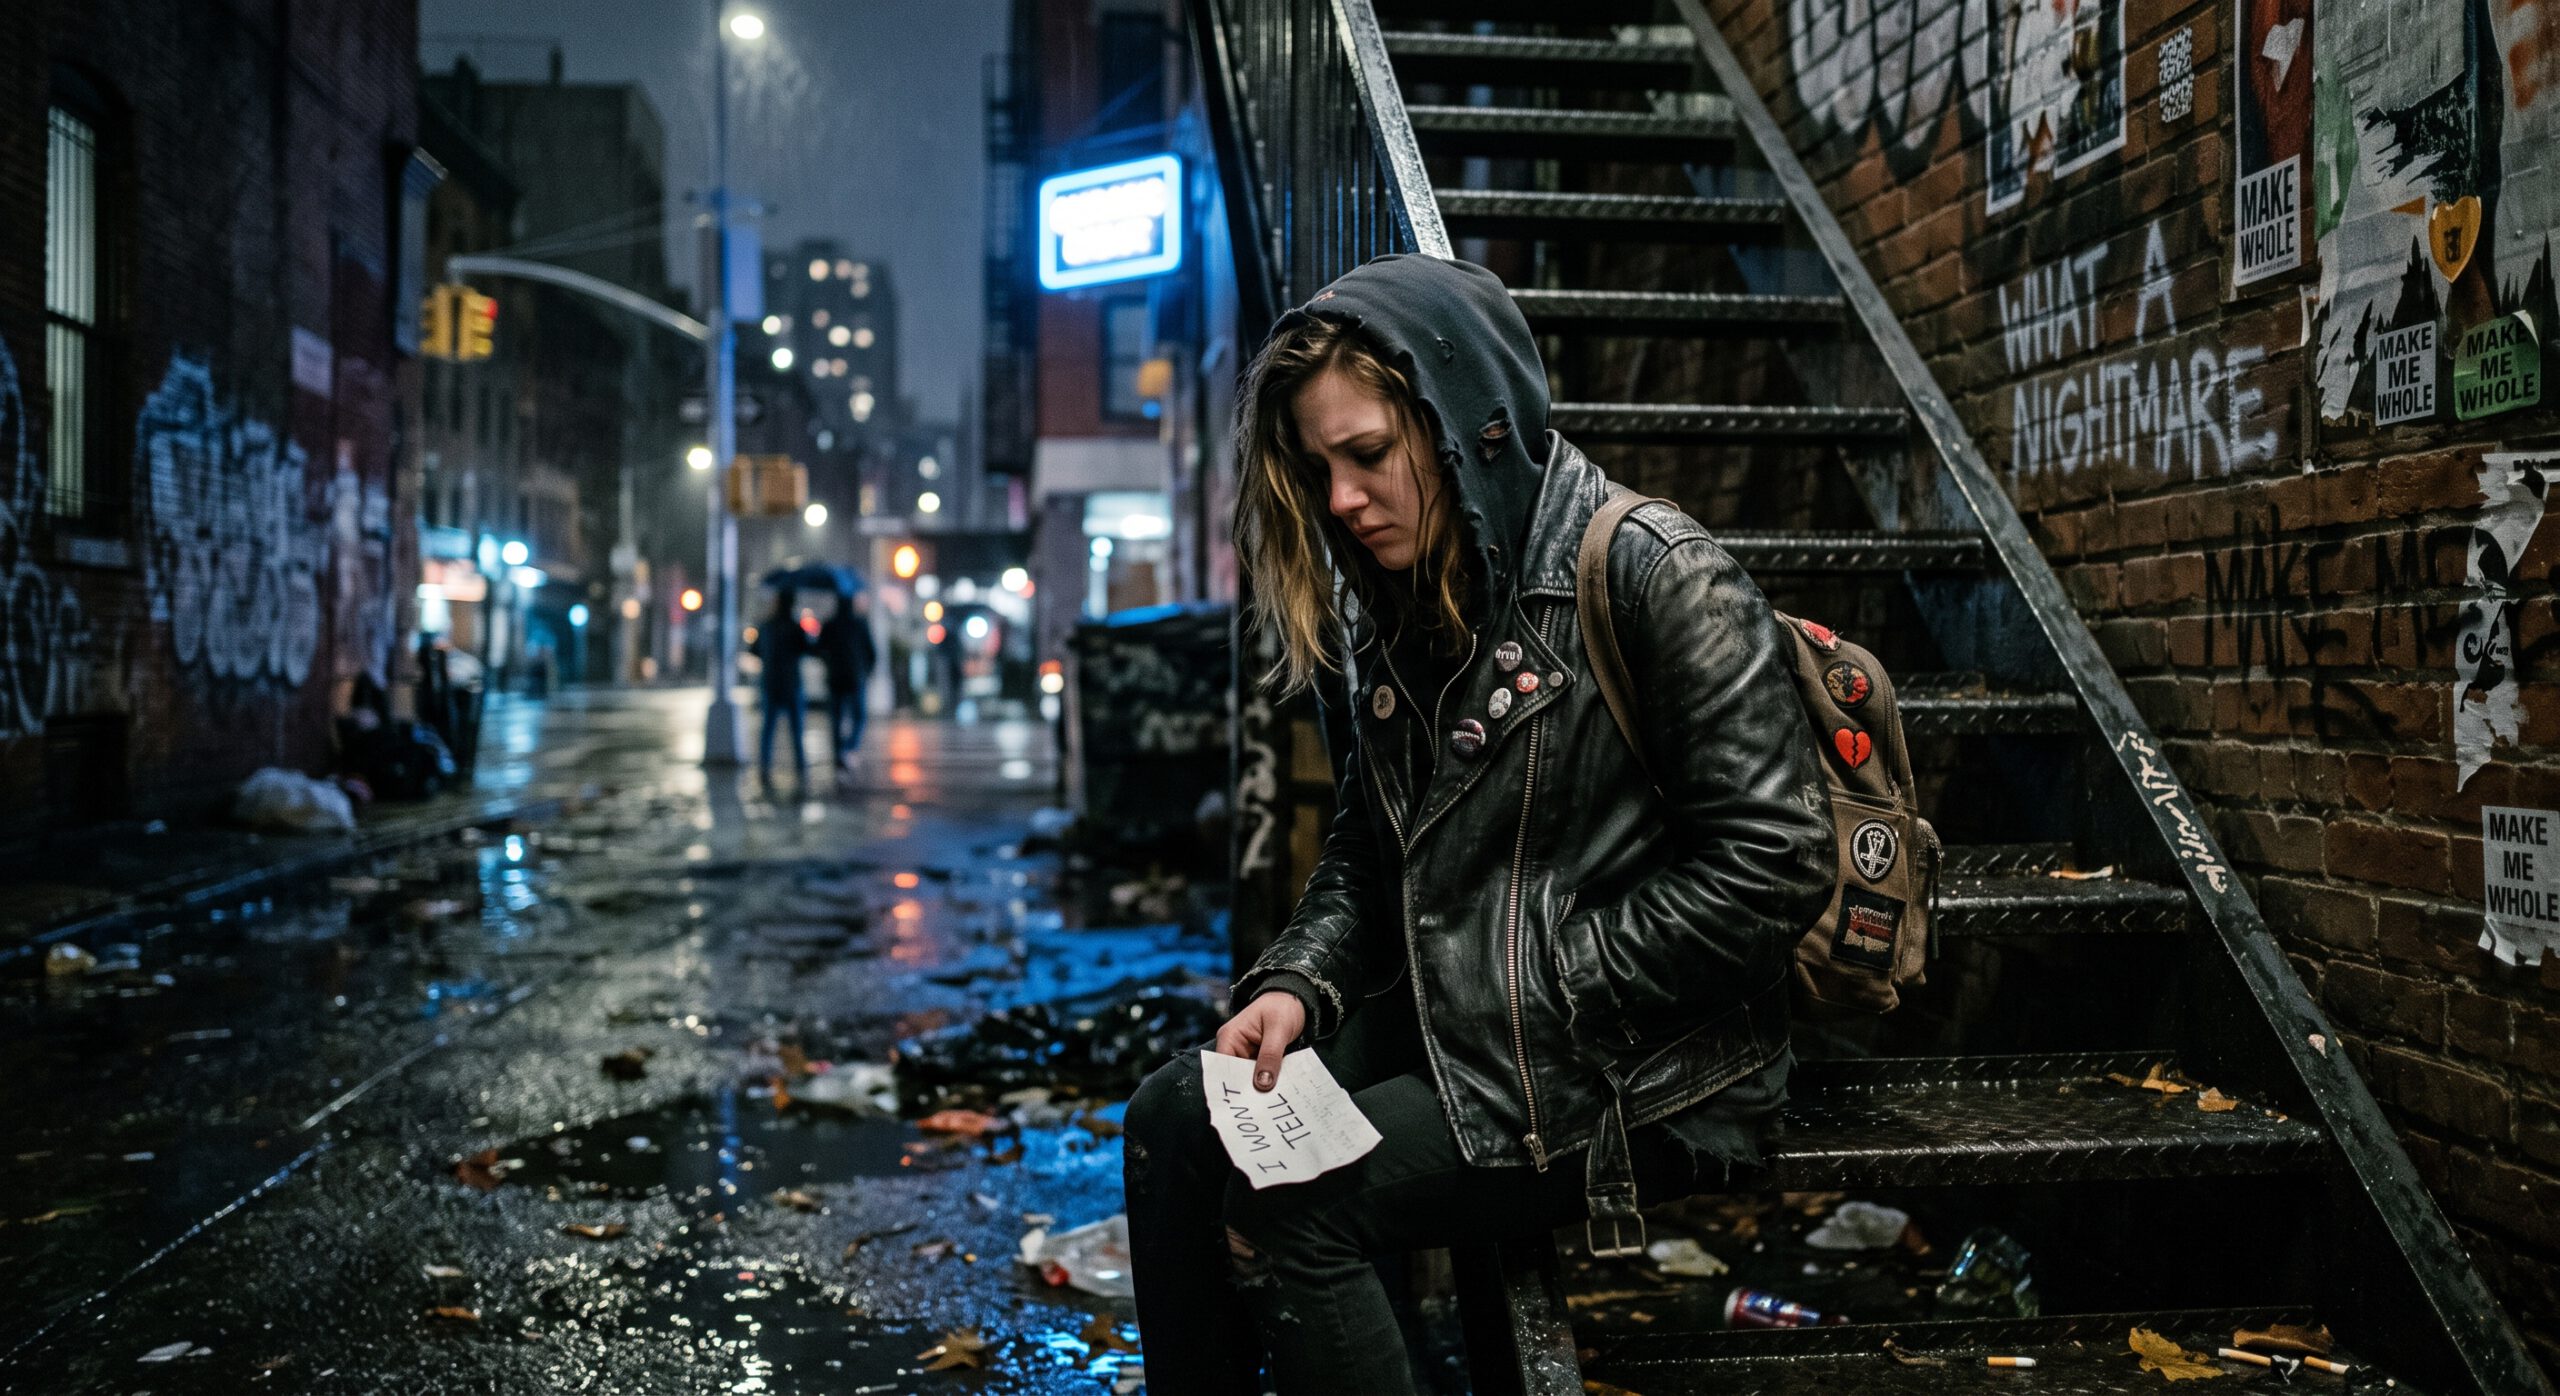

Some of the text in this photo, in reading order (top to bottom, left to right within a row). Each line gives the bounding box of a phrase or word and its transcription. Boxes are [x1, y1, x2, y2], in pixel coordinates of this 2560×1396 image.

[2241, 163, 2294, 231] MAKE
[2240, 216, 2294, 270] WHOLE
[1999, 219, 2178, 374] WHAT A
[2379, 326, 2432, 361] MAKE
[2466, 321, 2527, 358] MAKE
[2388, 355, 2420, 389] ME
[2480, 351, 2513, 381] ME
[2377, 384, 2432, 420] WHOLE
[2459, 373, 2535, 413] WHOLE
[2010, 345, 2278, 484] NIGHTMARE
[2489, 813, 2548, 846] MAKE
[2503, 850, 2534, 881] ME
[2487, 884, 2560, 922] WHOLE
[1223, 1081, 1287, 1173] I WON'T
[1267, 1093, 1311, 1150] TELL
